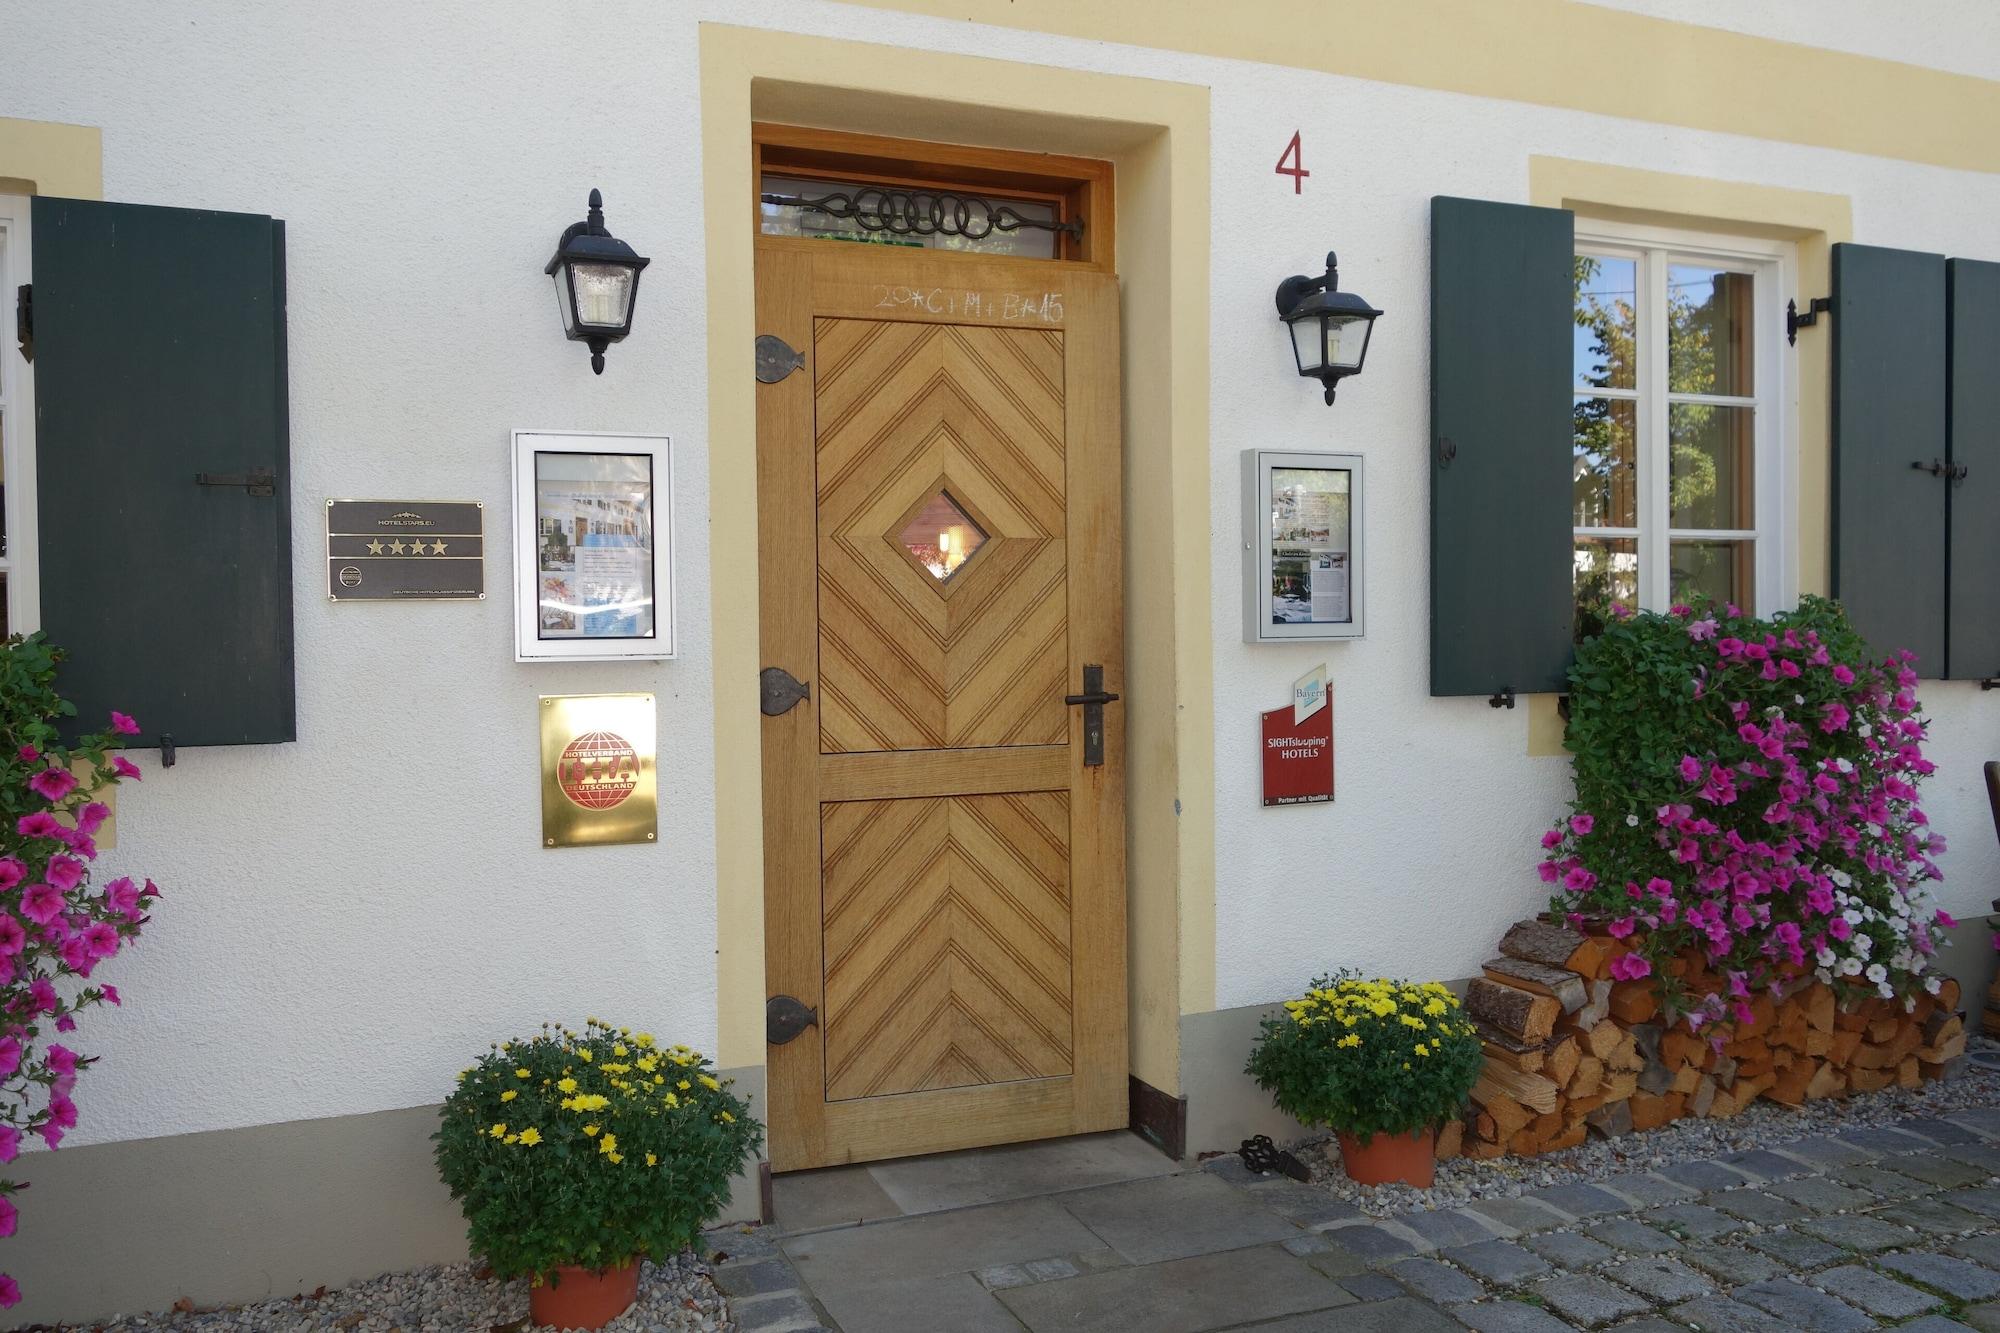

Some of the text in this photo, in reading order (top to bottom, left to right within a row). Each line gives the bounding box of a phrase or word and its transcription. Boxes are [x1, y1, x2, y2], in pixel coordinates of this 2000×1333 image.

[1275, 128, 1310, 195] 4
[565, 749, 633, 758] HOTELVERBAND
[1281, 748, 1319, 759] HOTELS
[565, 782, 634, 791] DEUTSCHLAND
